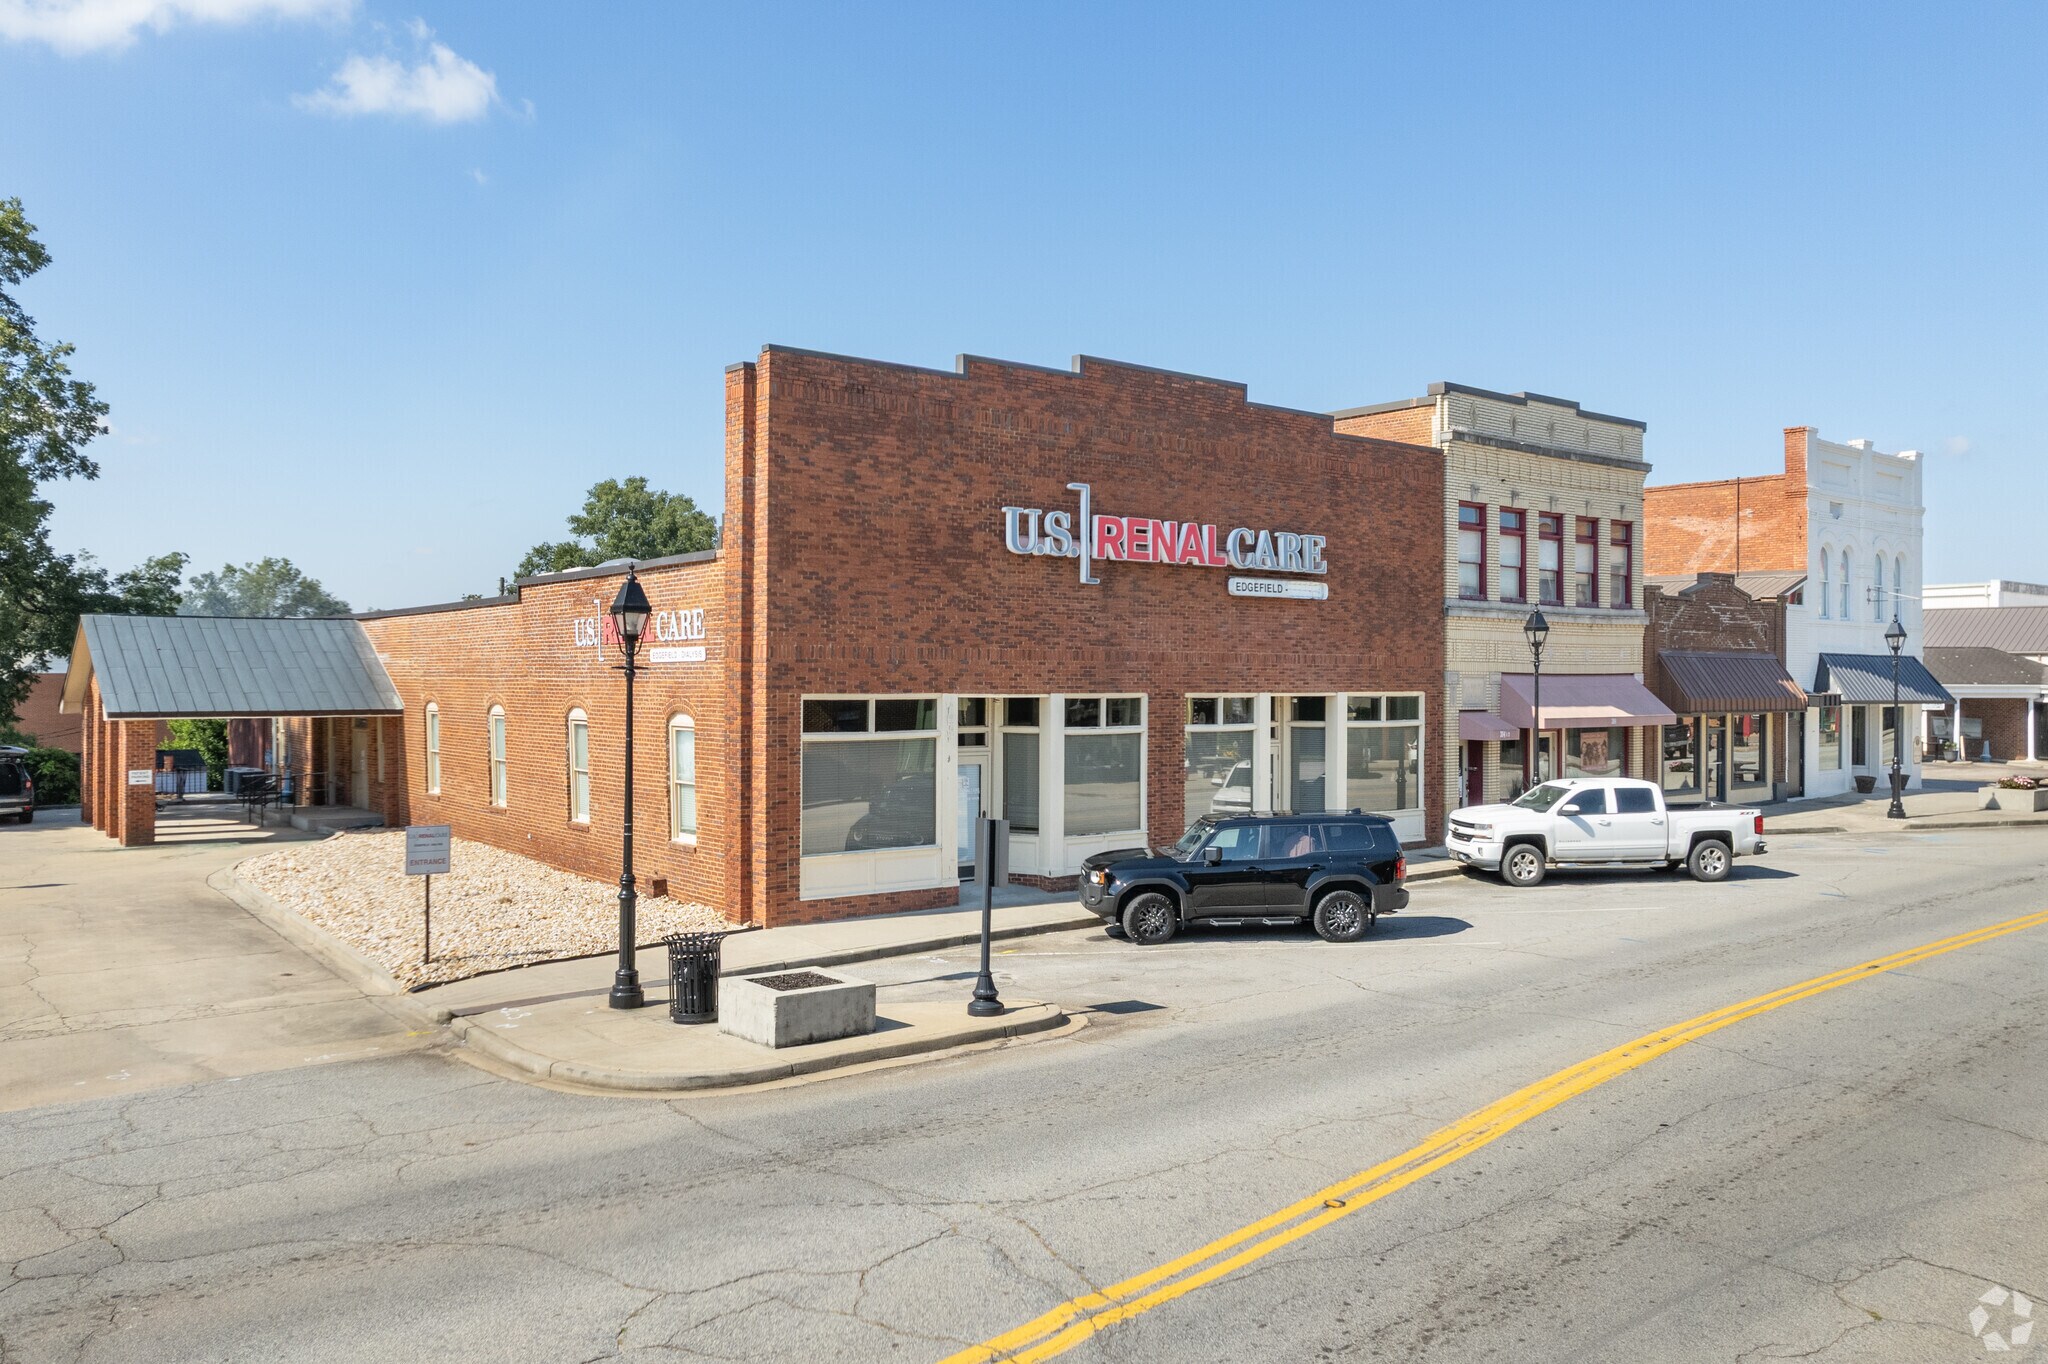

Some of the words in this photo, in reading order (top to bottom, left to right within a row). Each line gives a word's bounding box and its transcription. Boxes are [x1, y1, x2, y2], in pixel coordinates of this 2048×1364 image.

[1001, 506, 1080, 558] U.S.
[1093, 514, 1227, 567] RENAL
[1227, 527, 1328, 575] CARE
[1235, 581, 1284, 593] EDGEFIELD
[656, 608, 706, 641] CARE
[410, 857, 447, 866] ENTRANCE
